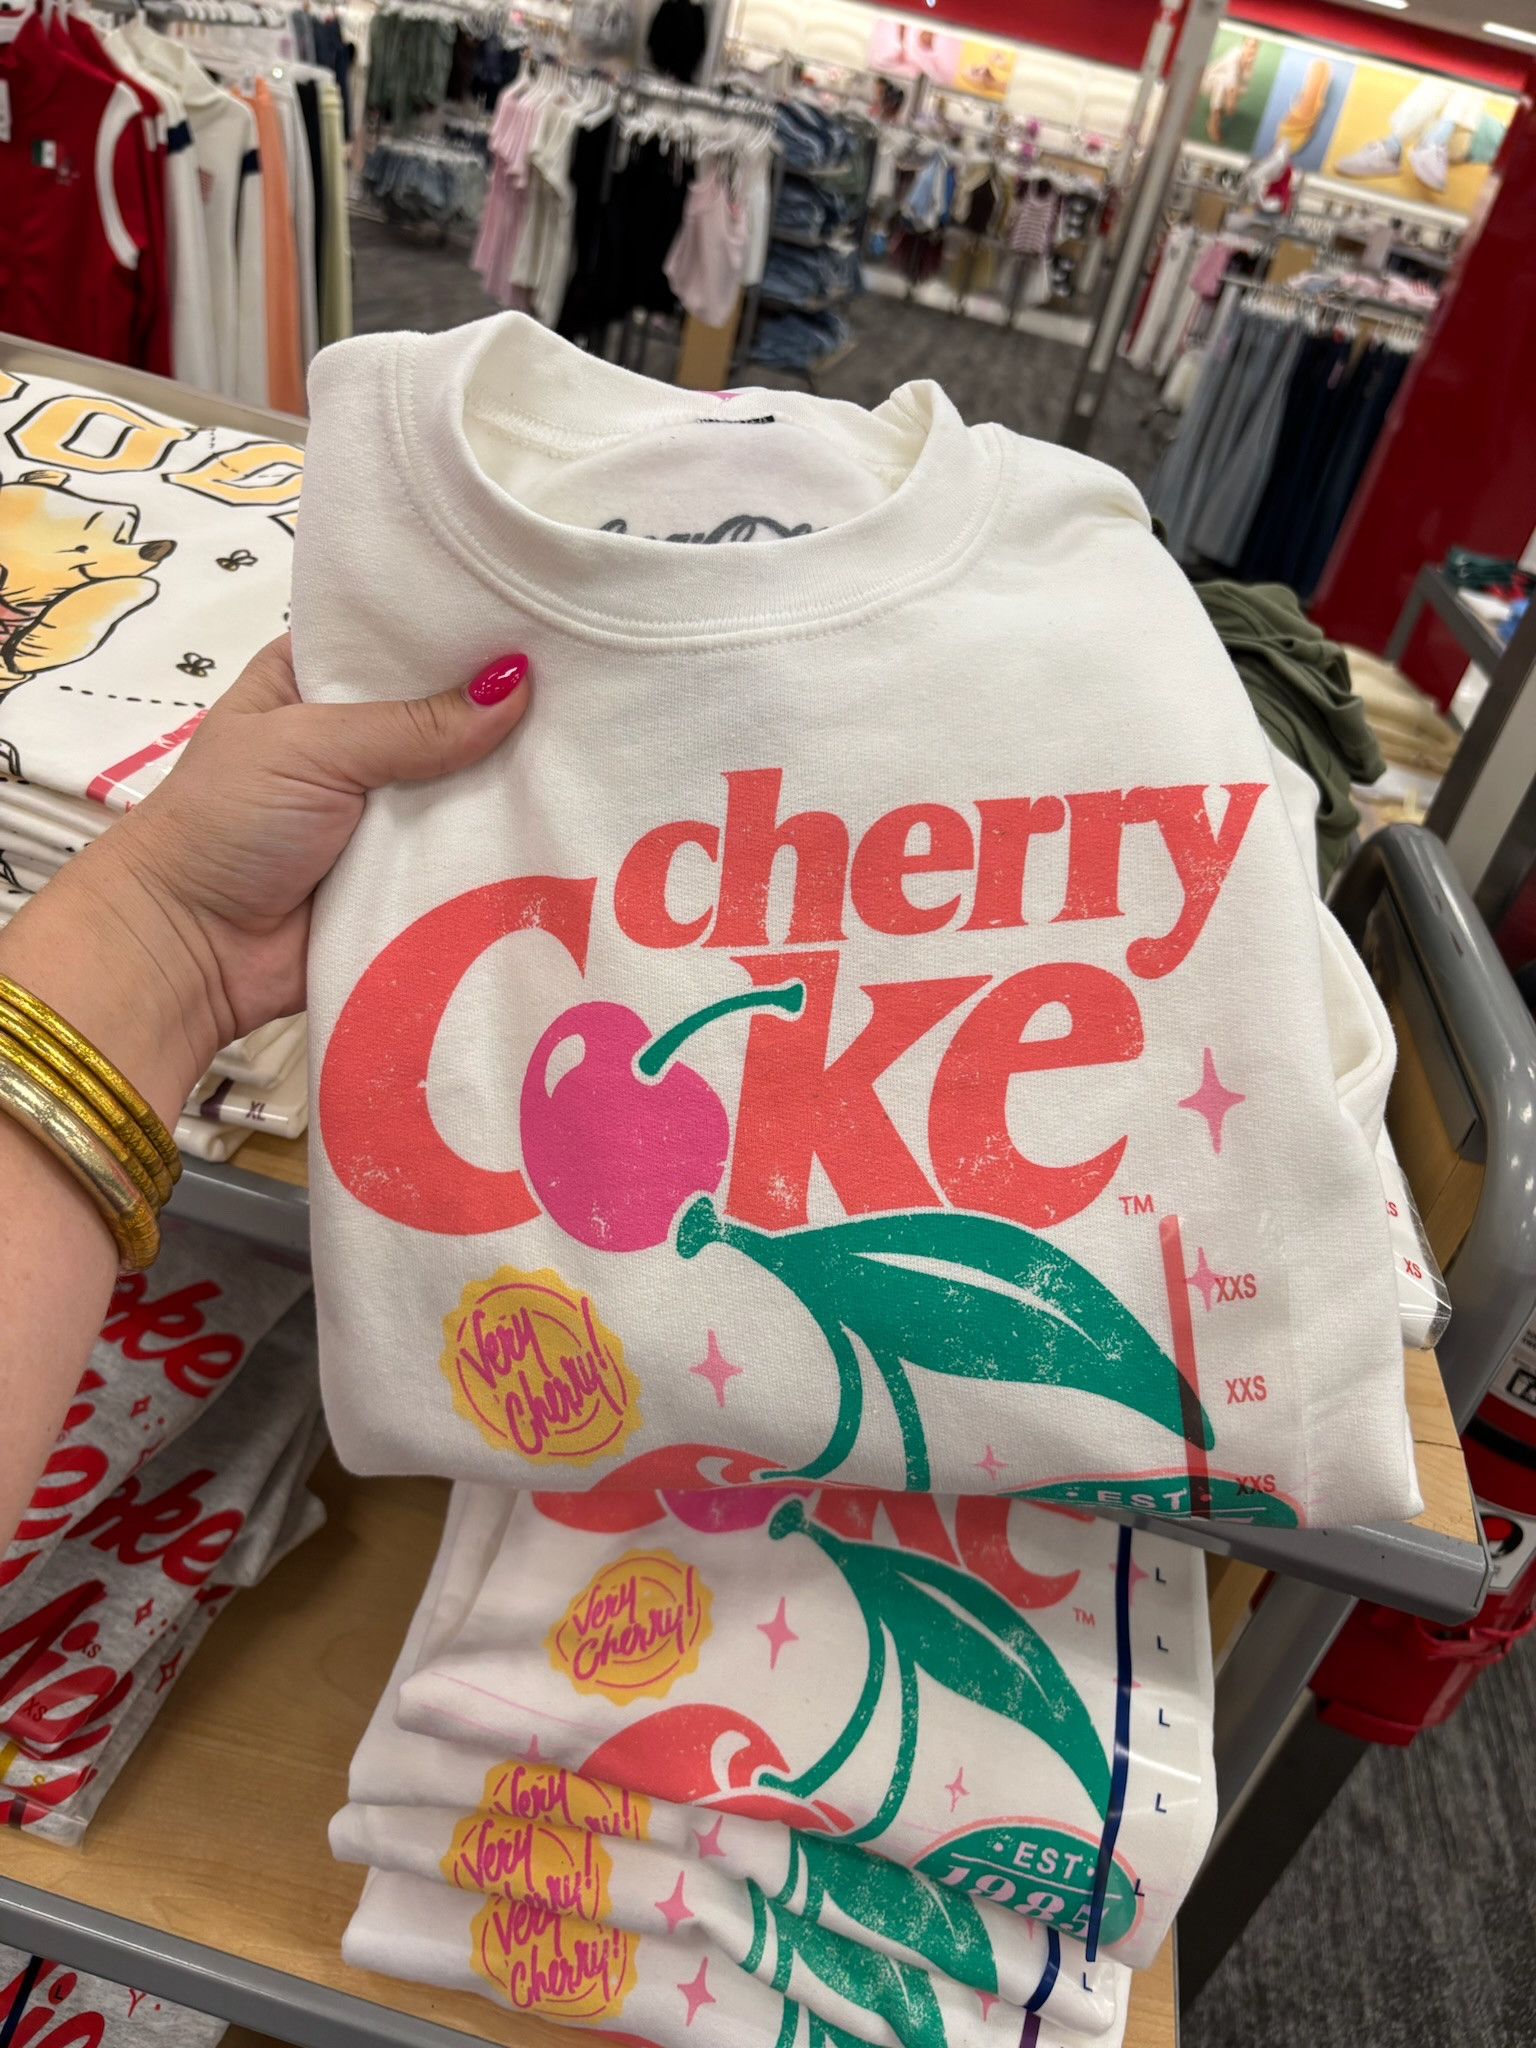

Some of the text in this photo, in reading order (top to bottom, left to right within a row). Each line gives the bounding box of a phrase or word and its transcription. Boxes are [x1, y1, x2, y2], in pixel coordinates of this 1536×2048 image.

[612, 767, 1270, 980] cherry
[246, 1101, 266, 1121] XL
[1119, 1194, 1154, 1215] TM
[1403, 1257, 1422, 1279] XS
[1214, 1273, 1257, 1302] XXS
[459, 1306, 554, 1389] Very
[505, 1296, 624, 1455] Cherry!
[1225, 1375, 1267, 1404] XXS
[1235, 1474, 1277, 1496] XXS
[1097, 1487, 1188, 1511] EST
[1156, 1567, 1166, 1584] L
[572, 1575, 637, 1636] Very
[1073, 1607, 1096, 1626] TM
[573, 1565, 694, 1680] Cherry!
[1157, 1635, 1169, 1653] L
[1159, 1708, 1171, 1728] L
[1155, 1793, 1167, 1813] L
[460, 1818, 535, 1893] Very
[1012, 1841, 1083, 1880] EST
[1134, 1878, 1145, 1897] L
[937, 1864, 1110, 1938] 1985
[511, 1928, 620, 2008] Cherry!
[54, 1985, 64, 2001] L
[1083, 1972, 1093, 1992] L
